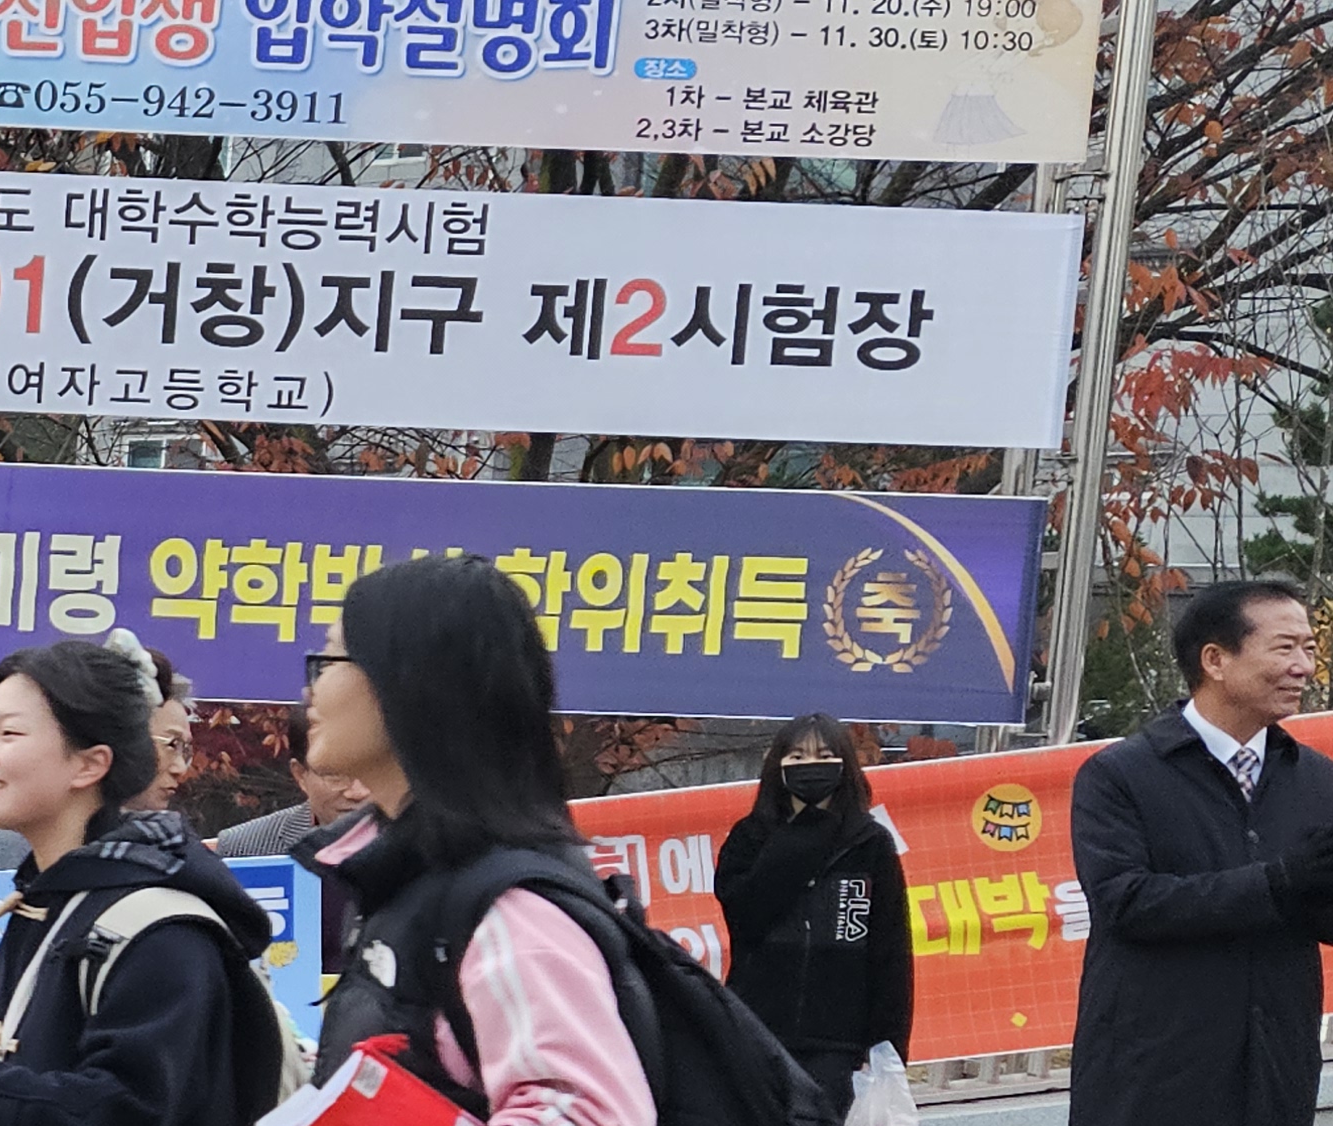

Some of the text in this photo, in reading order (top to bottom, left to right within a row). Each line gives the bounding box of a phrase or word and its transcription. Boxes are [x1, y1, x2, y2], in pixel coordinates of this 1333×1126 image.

[644, 17, 780, 47] 3차(밀착형)
[868, 27, 948, 51] 30.(토)
[961, 30, 1033, 51] 10:30
[644, 59, 689, 78] 장소
[34, 80, 347, 125] 055-942-3911
[665, 85, 705, 110] 1차
[742, 86, 793, 113] 본교
[803, 90, 879, 115] 체육관
[635, 118, 703, 142] 2,3차
[740, 119, 790, 145] 본교
[800, 122, 877, 148] 소강당
[64, 184, 490, 257] 대학수학능력시험
[522, 277, 935, 372] 제2시험장
[495, 547, 808, 659] 학위취득
[855, 573, 919, 644] 축
[845, 879, 871, 941] FILA
